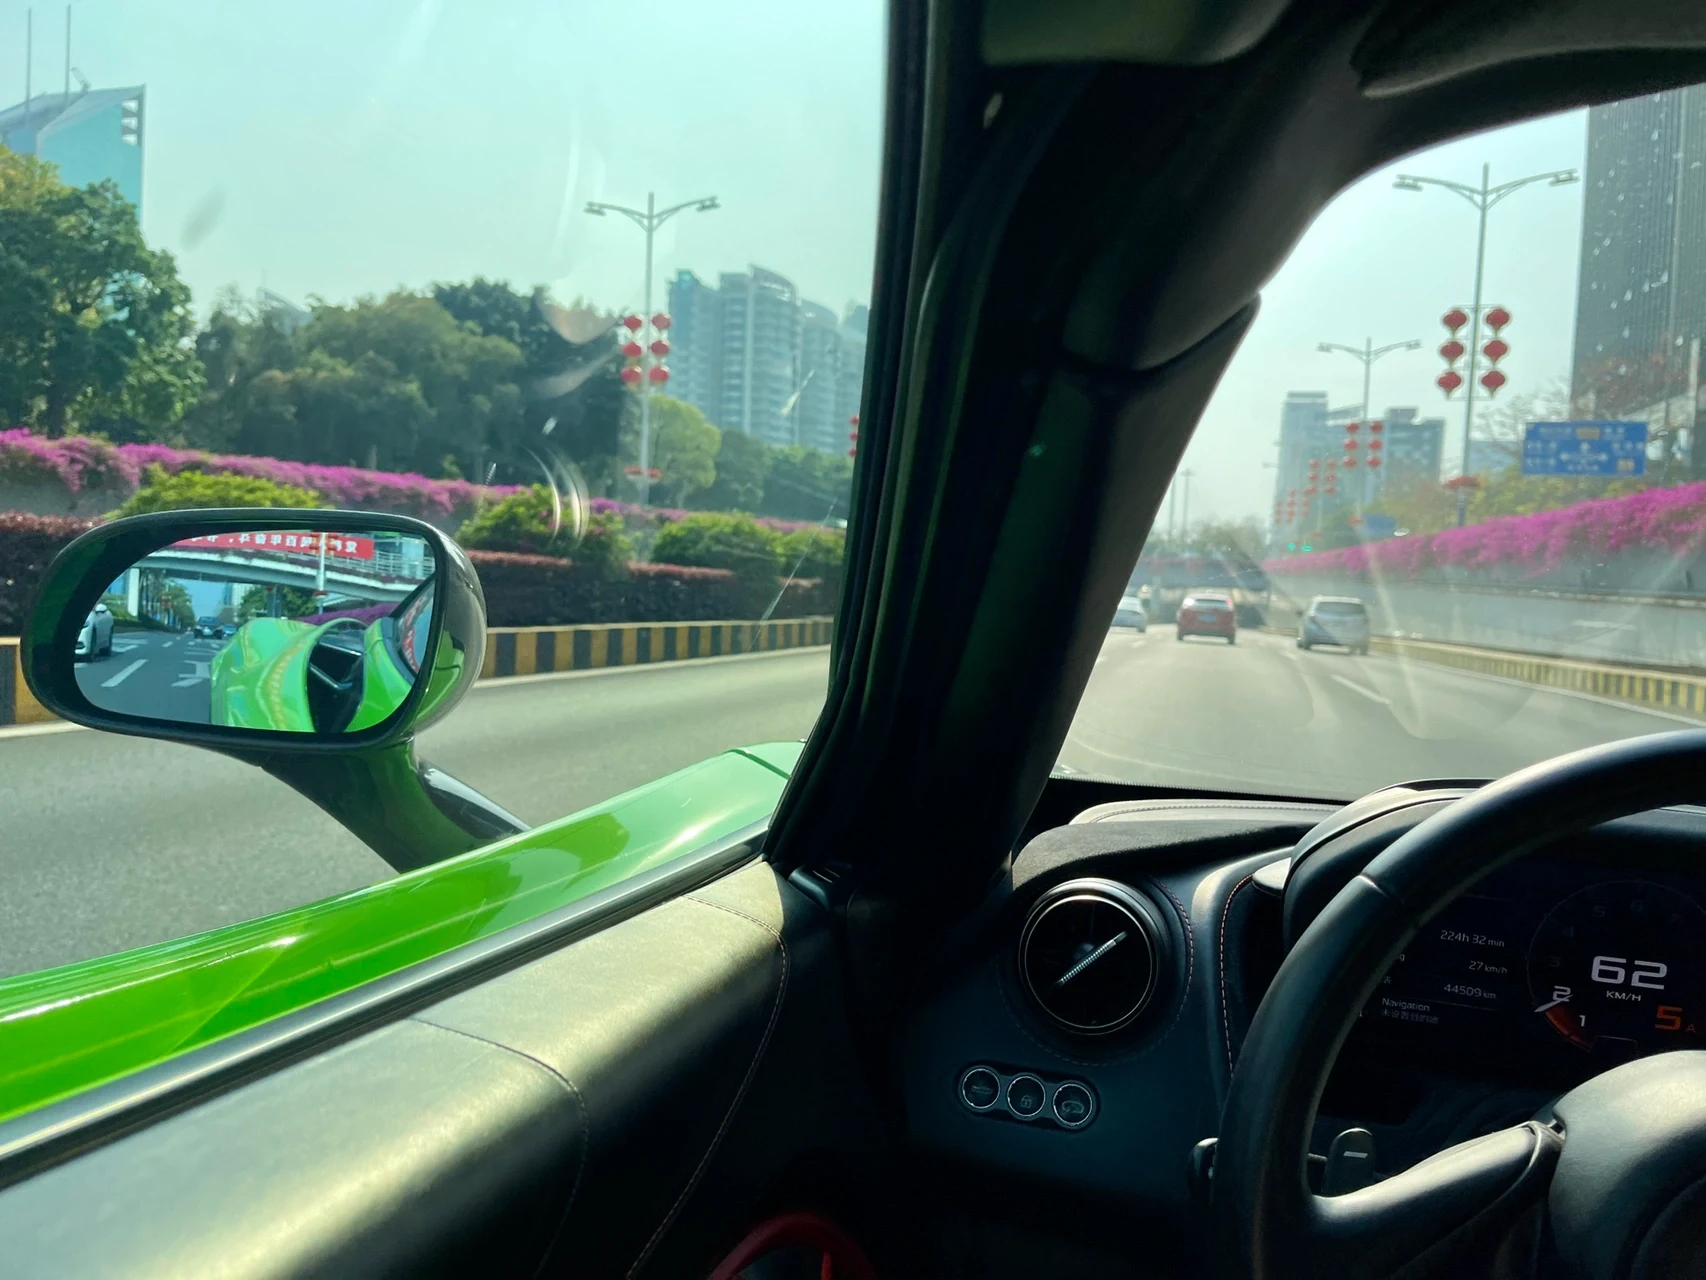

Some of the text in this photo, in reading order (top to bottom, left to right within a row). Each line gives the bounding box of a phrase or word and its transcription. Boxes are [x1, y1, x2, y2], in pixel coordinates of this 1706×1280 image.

[1440, 929, 1506, 948] 224h 32 min
[1468, 960, 1508, 975] 27 km/h
[1591, 955, 1669, 990] 62
[1443, 983, 1497, 1000] 44509 km
[1552, 985, 1572, 1003] 2
[1605, 990, 1642, 1002] KM/H
[1381, 997, 1431, 1013] Navigation
[1578, 1014, 1587, 1027] 1
[1654, 1004, 1697, 1034] 5 A
